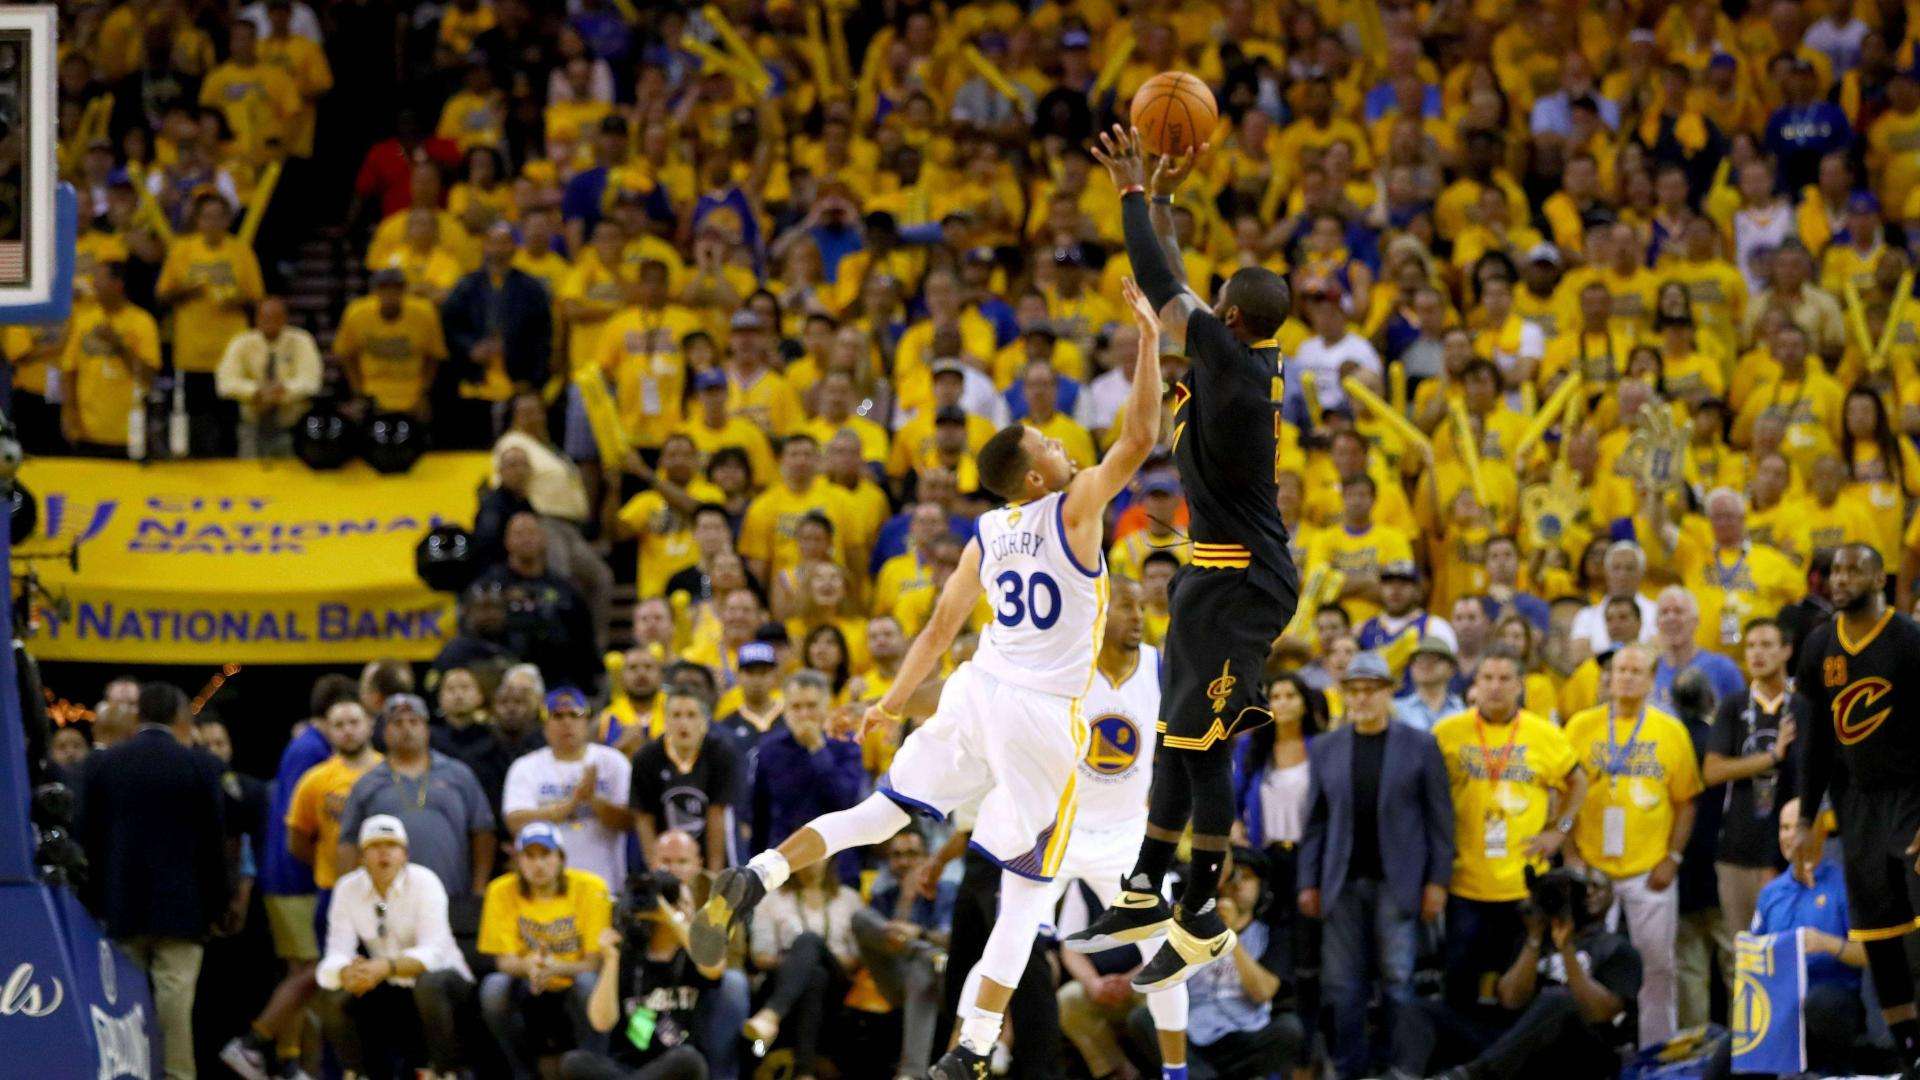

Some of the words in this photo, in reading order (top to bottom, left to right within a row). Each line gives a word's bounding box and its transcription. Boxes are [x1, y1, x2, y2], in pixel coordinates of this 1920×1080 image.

[146, 496, 273, 513] CITY
[127, 538, 305, 554] BANK
[991, 532, 1044, 561] CURRY
[996, 569, 1062, 631] 30
[77, 601, 309, 643] NATIONAL
[318, 602, 444, 642] BANK
[1823, 655, 1848, 688] 23
